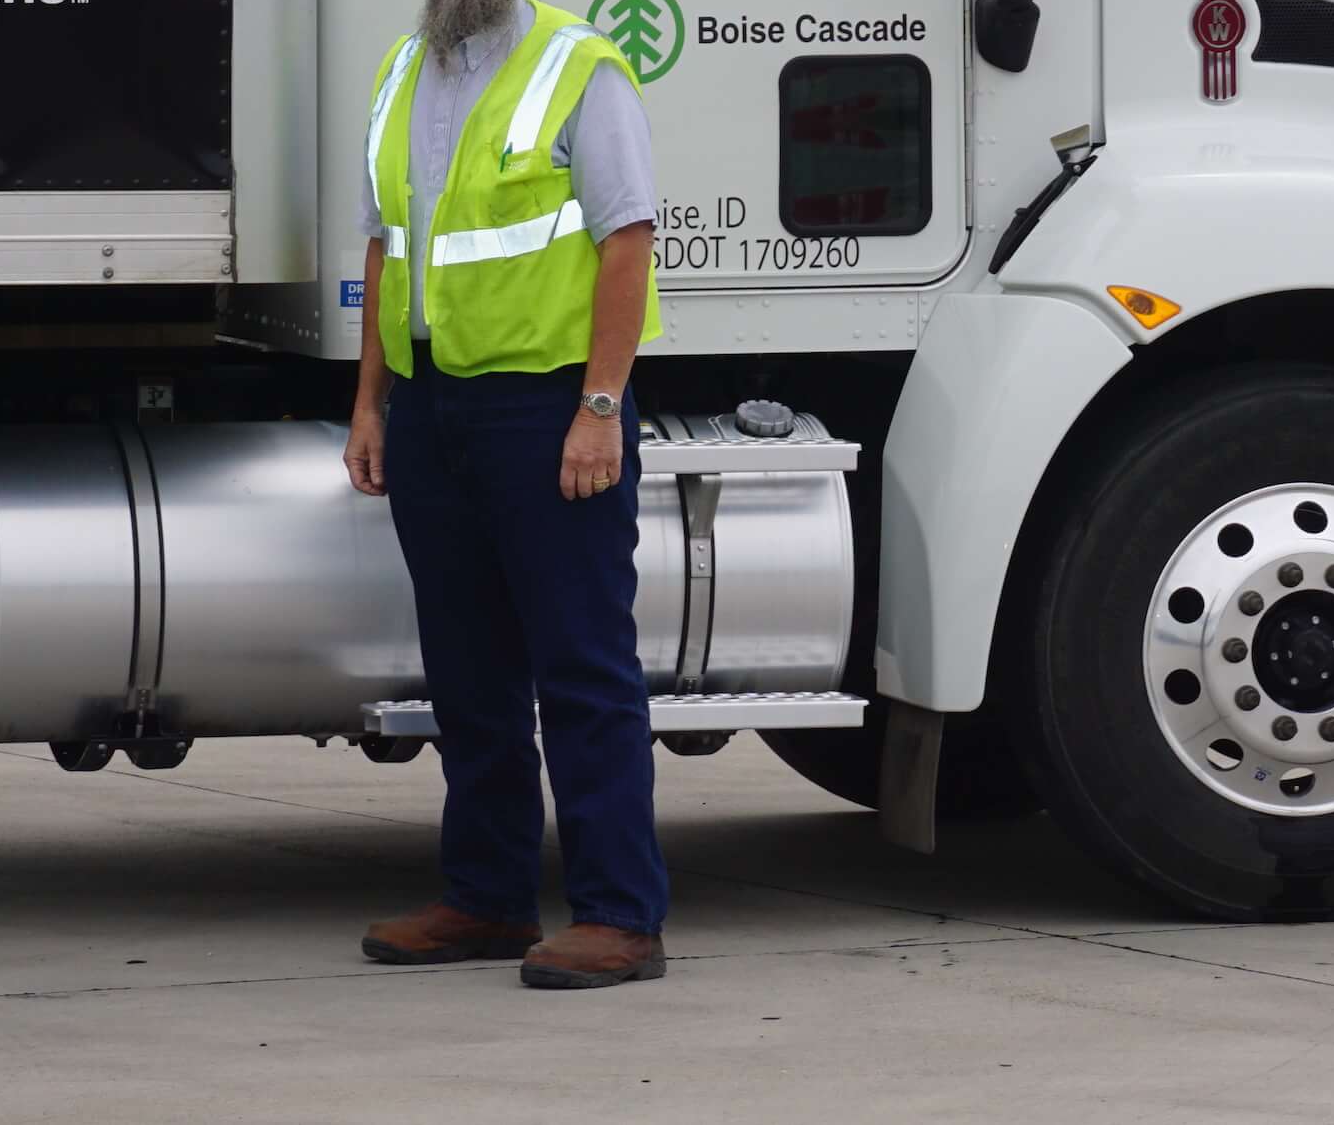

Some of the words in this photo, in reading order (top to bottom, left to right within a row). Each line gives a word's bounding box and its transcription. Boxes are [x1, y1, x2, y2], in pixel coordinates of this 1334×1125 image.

[698, 15, 784, 44] Boise
[795, 13, 926, 43] Cascade
[656, 198, 706, 232] ise,
[718, 197, 746, 228] ID
[653, 236, 726, 270] SDOT
[740, 236, 860, 271] 1709260
